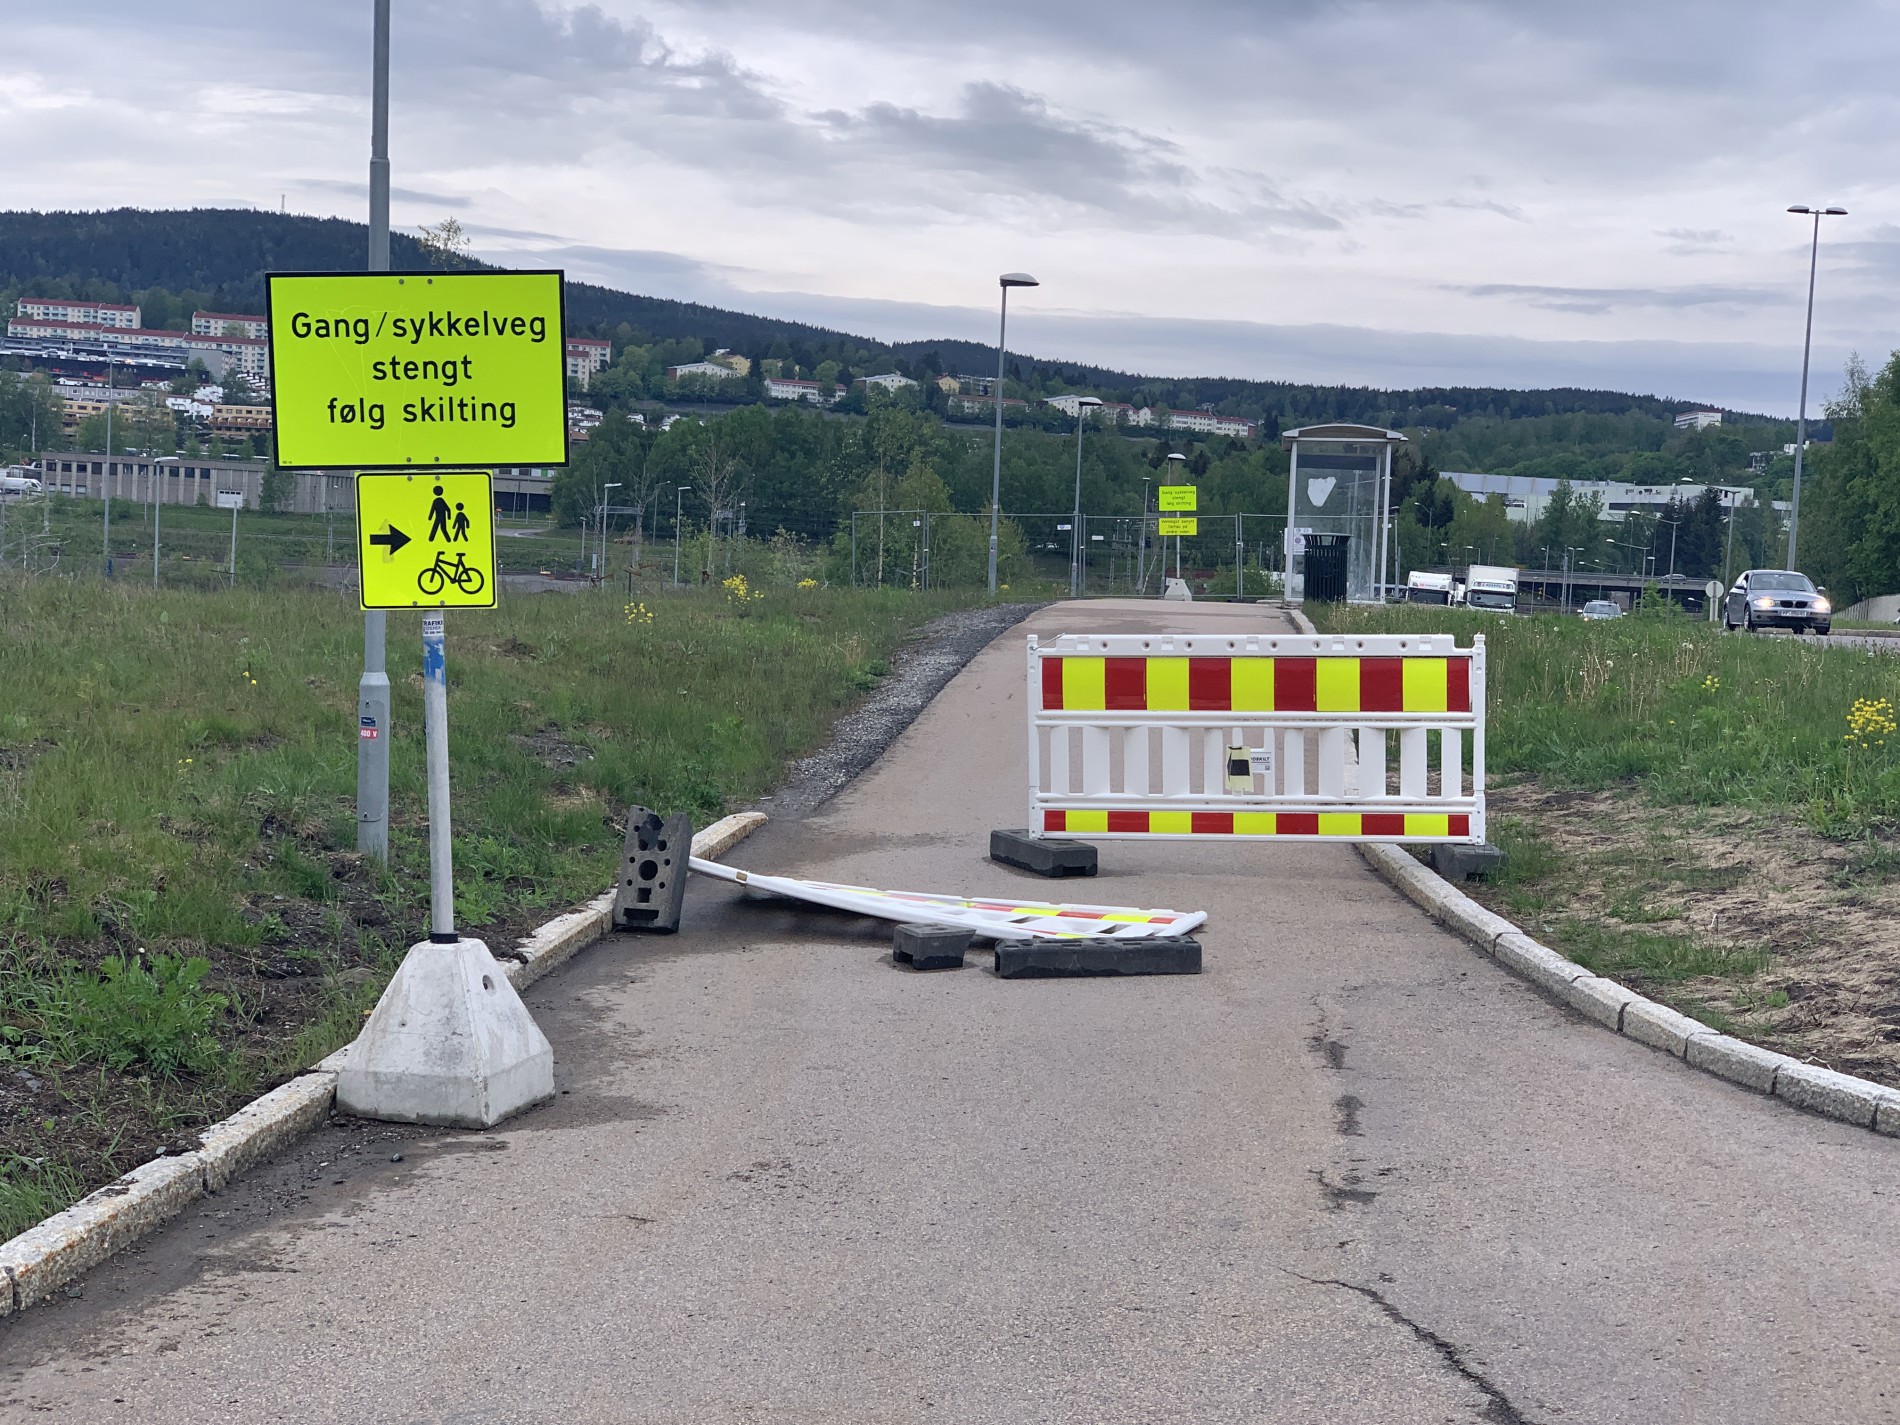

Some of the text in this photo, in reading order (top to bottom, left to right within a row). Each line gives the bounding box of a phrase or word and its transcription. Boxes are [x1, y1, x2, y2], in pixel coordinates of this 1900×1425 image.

[291, 310, 546, 345] Gang/sykkelveg
[372, 354, 473, 386] stengt
[327, 395, 516, 430] følg skilting
[372, 730, 378, 738] V
